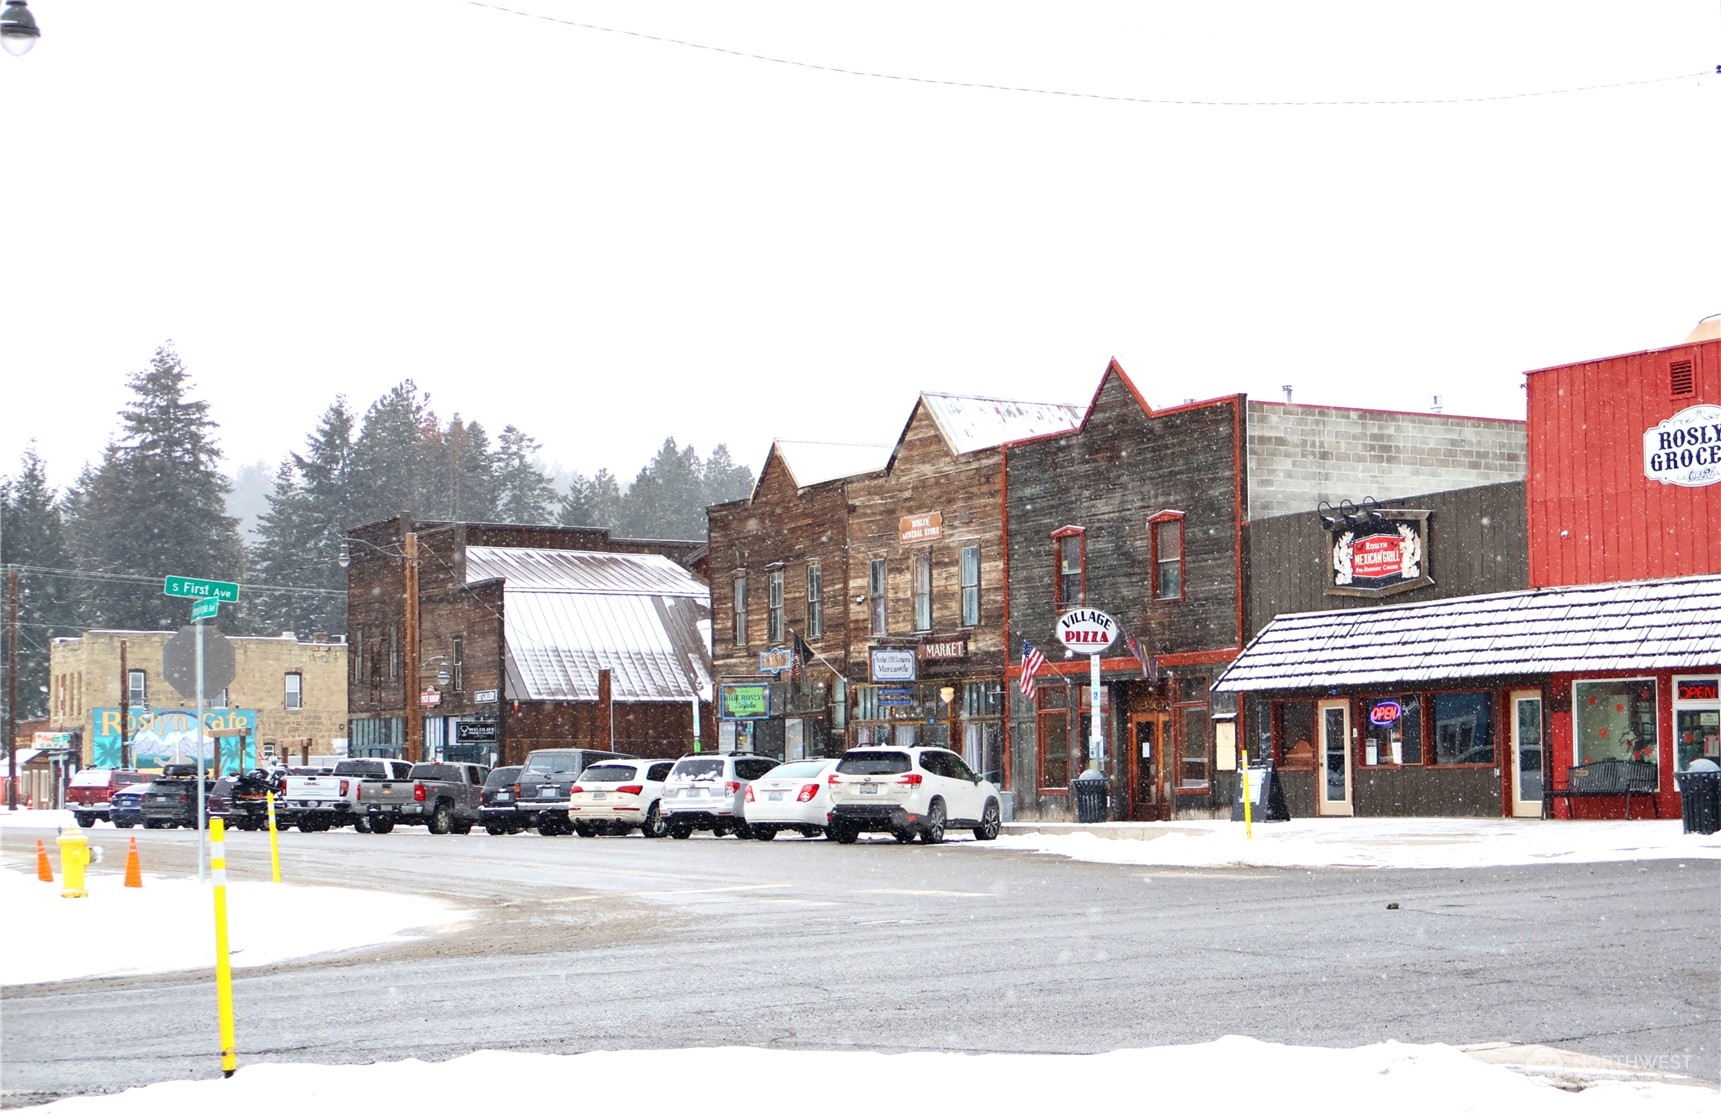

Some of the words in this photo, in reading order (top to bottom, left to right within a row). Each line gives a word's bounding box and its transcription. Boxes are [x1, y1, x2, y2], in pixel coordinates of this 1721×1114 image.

[1354, 552, 1383, 566] MEXICAN
[1383, 549, 1400, 563] GRILL
[172, 583, 179, 592] S
[183, 581, 210, 595] First
[213, 588, 231, 598] Ave
[1061, 611, 1113, 631] VILLAGE
[1065, 631, 1109, 643] PIZZA
[926, 641, 964, 657] MARKET
[1678, 686, 1717, 699] OPEN
[1372, 705, 1398, 720] OPEN
[101, 711, 188, 737] Roslyn
